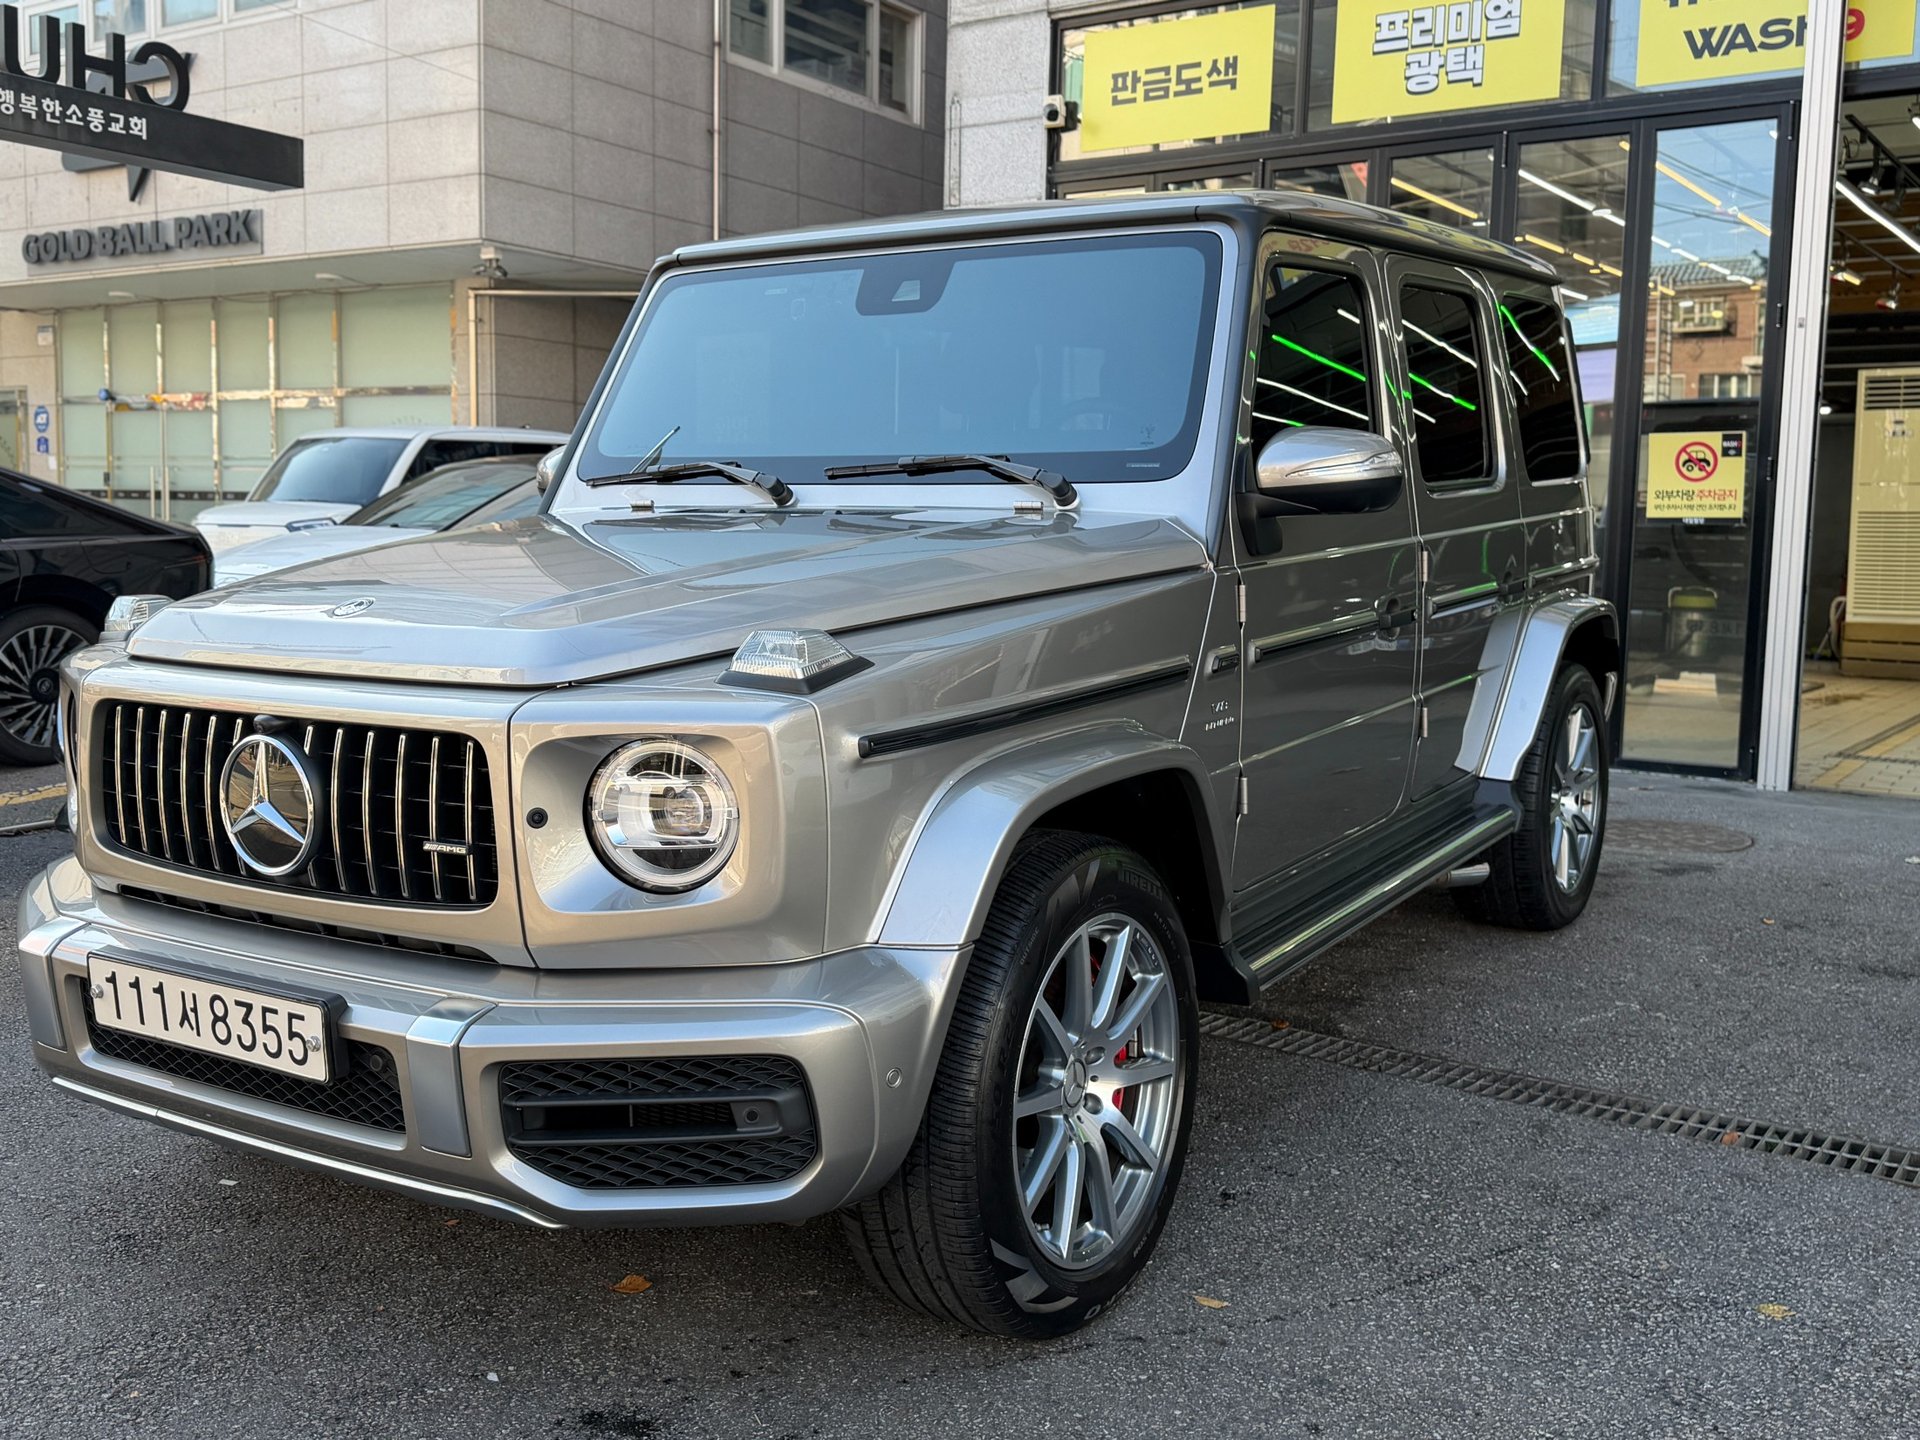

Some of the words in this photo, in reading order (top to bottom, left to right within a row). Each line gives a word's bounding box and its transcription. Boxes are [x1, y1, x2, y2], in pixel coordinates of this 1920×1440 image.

[1372, 0, 1521, 55] 프리미엄
[1110, 55, 1239, 106] 판금도색
[1403, 43, 1485, 96] 광택
[0, 87, 148, 140] 행복한소풍교회
[22, 229, 93, 264] GOLD
[97, 220, 167, 257] BALL
[173, 209, 255, 249] PARK
[1654, 489, 1695, 501] 외부차량
[1696, 488, 1738, 501] 주차금지
[436, 844, 467, 854] AMG
